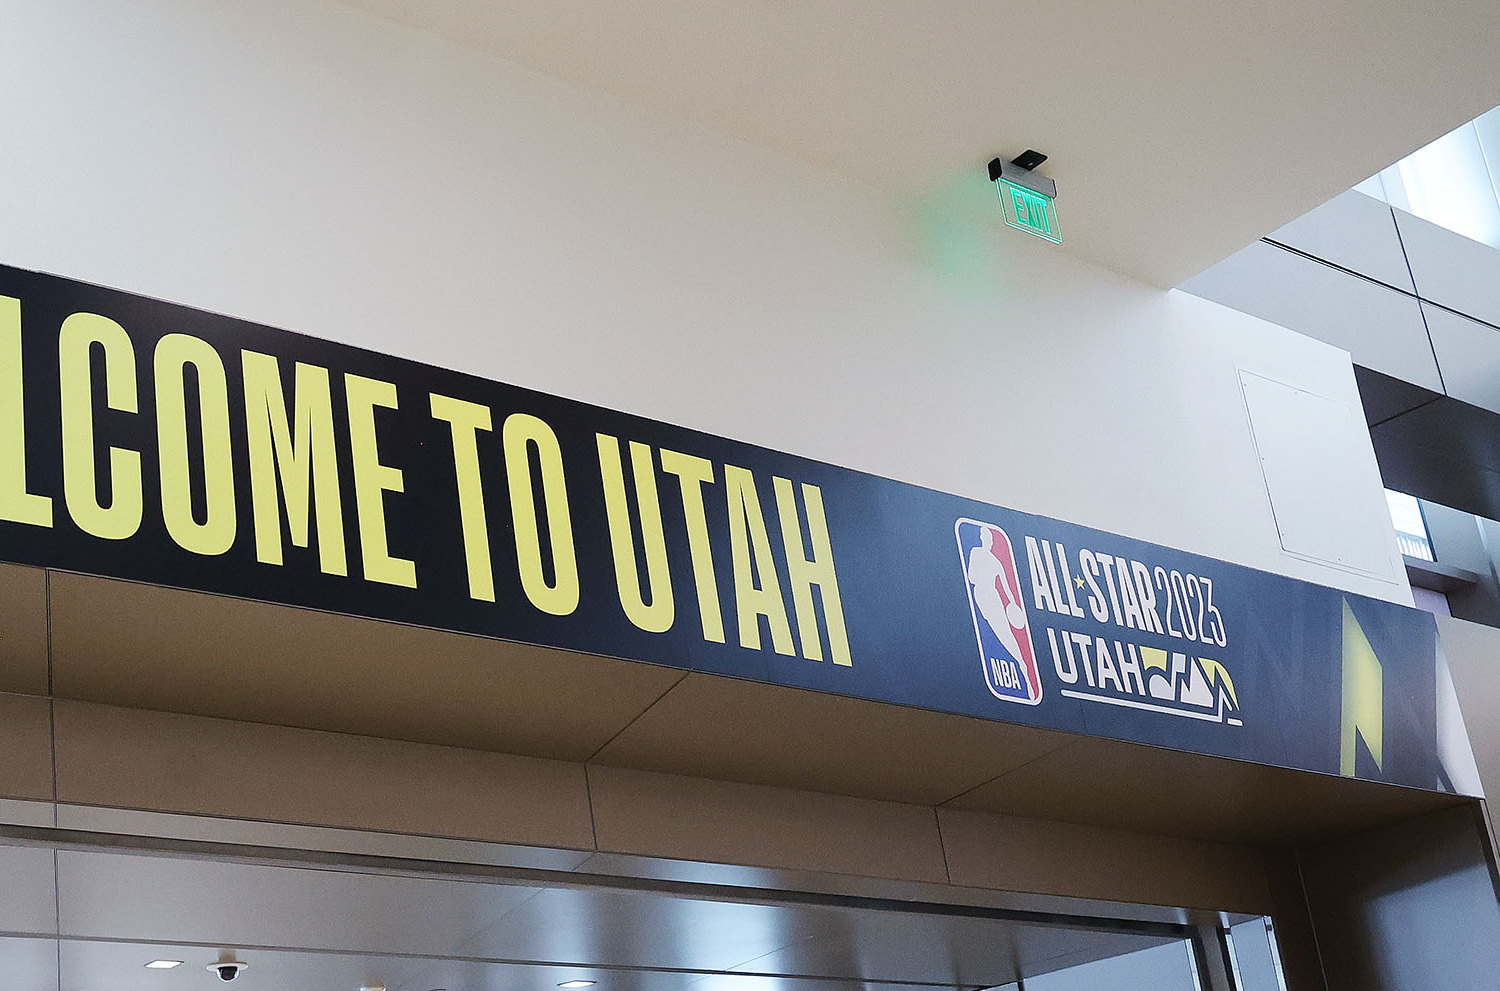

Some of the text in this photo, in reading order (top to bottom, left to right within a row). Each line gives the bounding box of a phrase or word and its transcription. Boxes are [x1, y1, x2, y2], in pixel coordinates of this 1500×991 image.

[1010, 186, 1051, 234] EXIT
[429, 391, 581, 617] TO
[596, 431, 853, 668] UTAH
[1156, 567, 1227, 648] 2023
[990, 657, 1022, 692] NBA
[1046, 627, 1146, 696] UTAH
